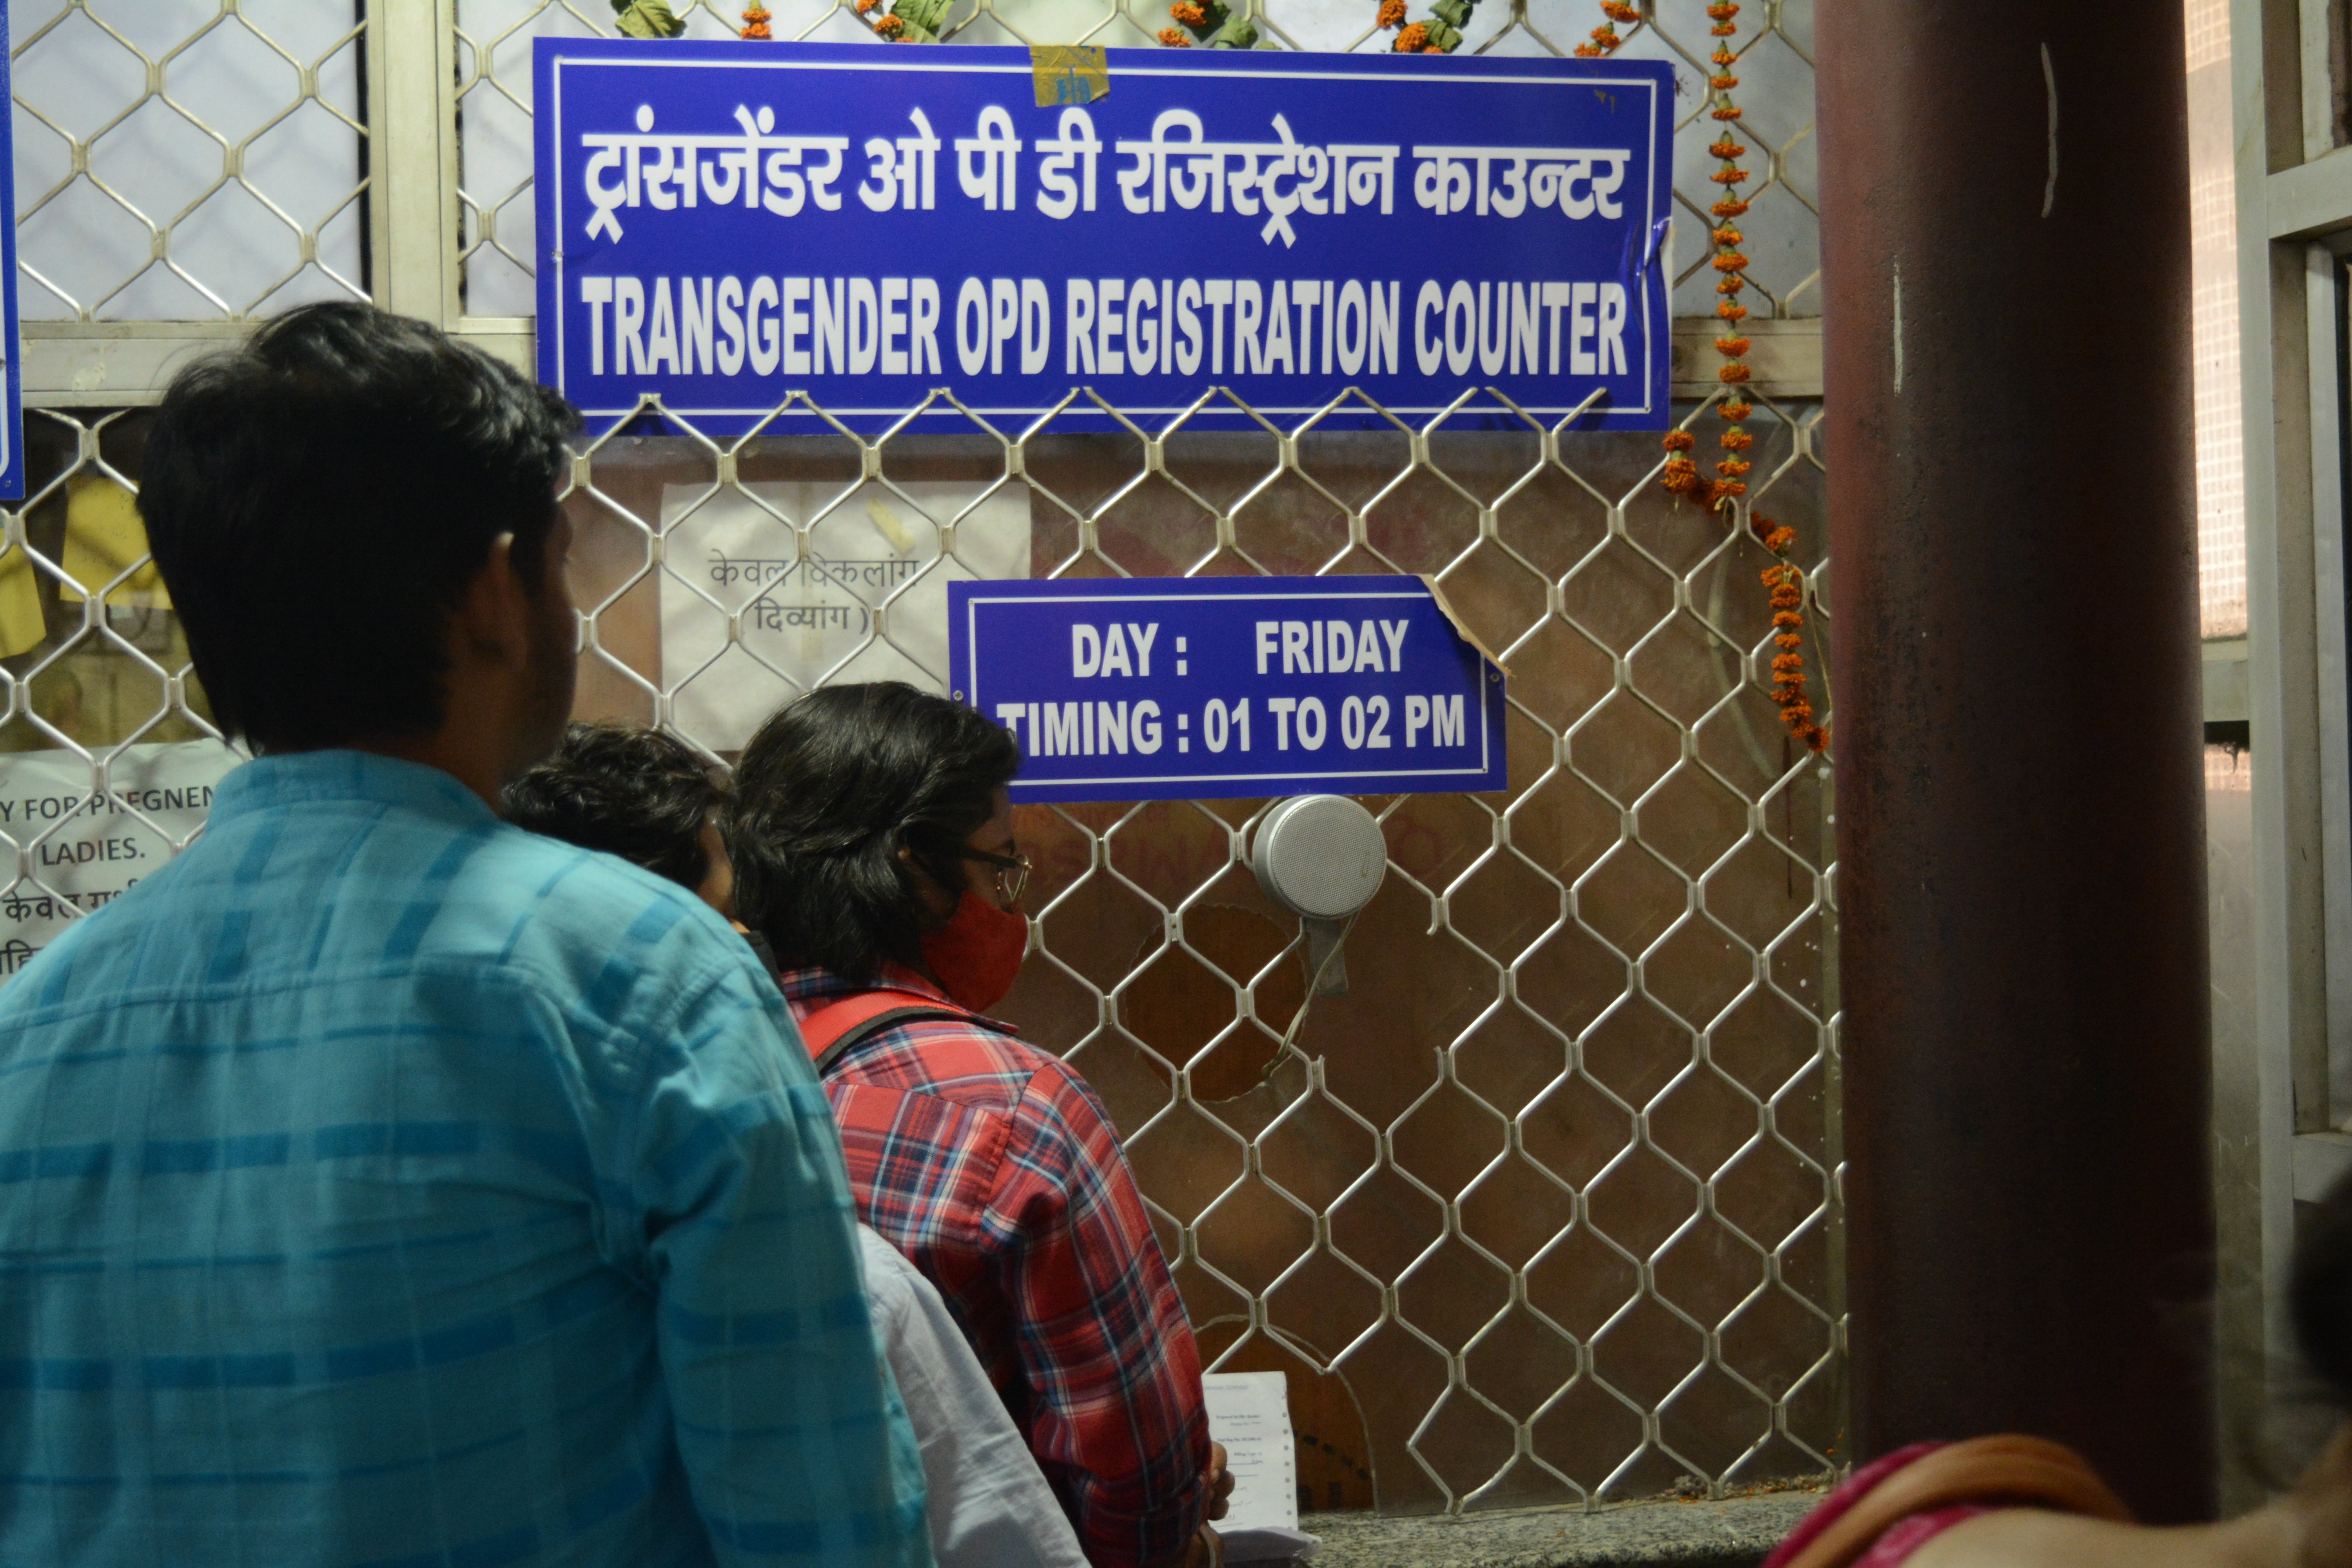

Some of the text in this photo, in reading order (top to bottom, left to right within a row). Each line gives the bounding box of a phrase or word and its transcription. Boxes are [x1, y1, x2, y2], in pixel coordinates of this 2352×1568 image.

[581, 103, 1630, 249] ट्रांसजेंडर ओ पी डी रजिस्ट्रेशन काउन्टर
[581, 276, 1627, 376] TRANSGENDER OPD REGISTRATION COUNTER
[708, 549, 789, 586] केवल
[1072, 623, 1159, 677] DAY
[1256, 620, 1408, 674] FRIDAY
[996, 700, 1162, 756] TIMING
[1204, 698, 1250, 753] 01
[1269, 697, 1326, 750] TO
[1341, 695, 1390, 750] 02
[1405, 695, 1465, 747] PM
[25, 796, 80, 819] FOR
[42, 838, 145, 866] LADIES.
